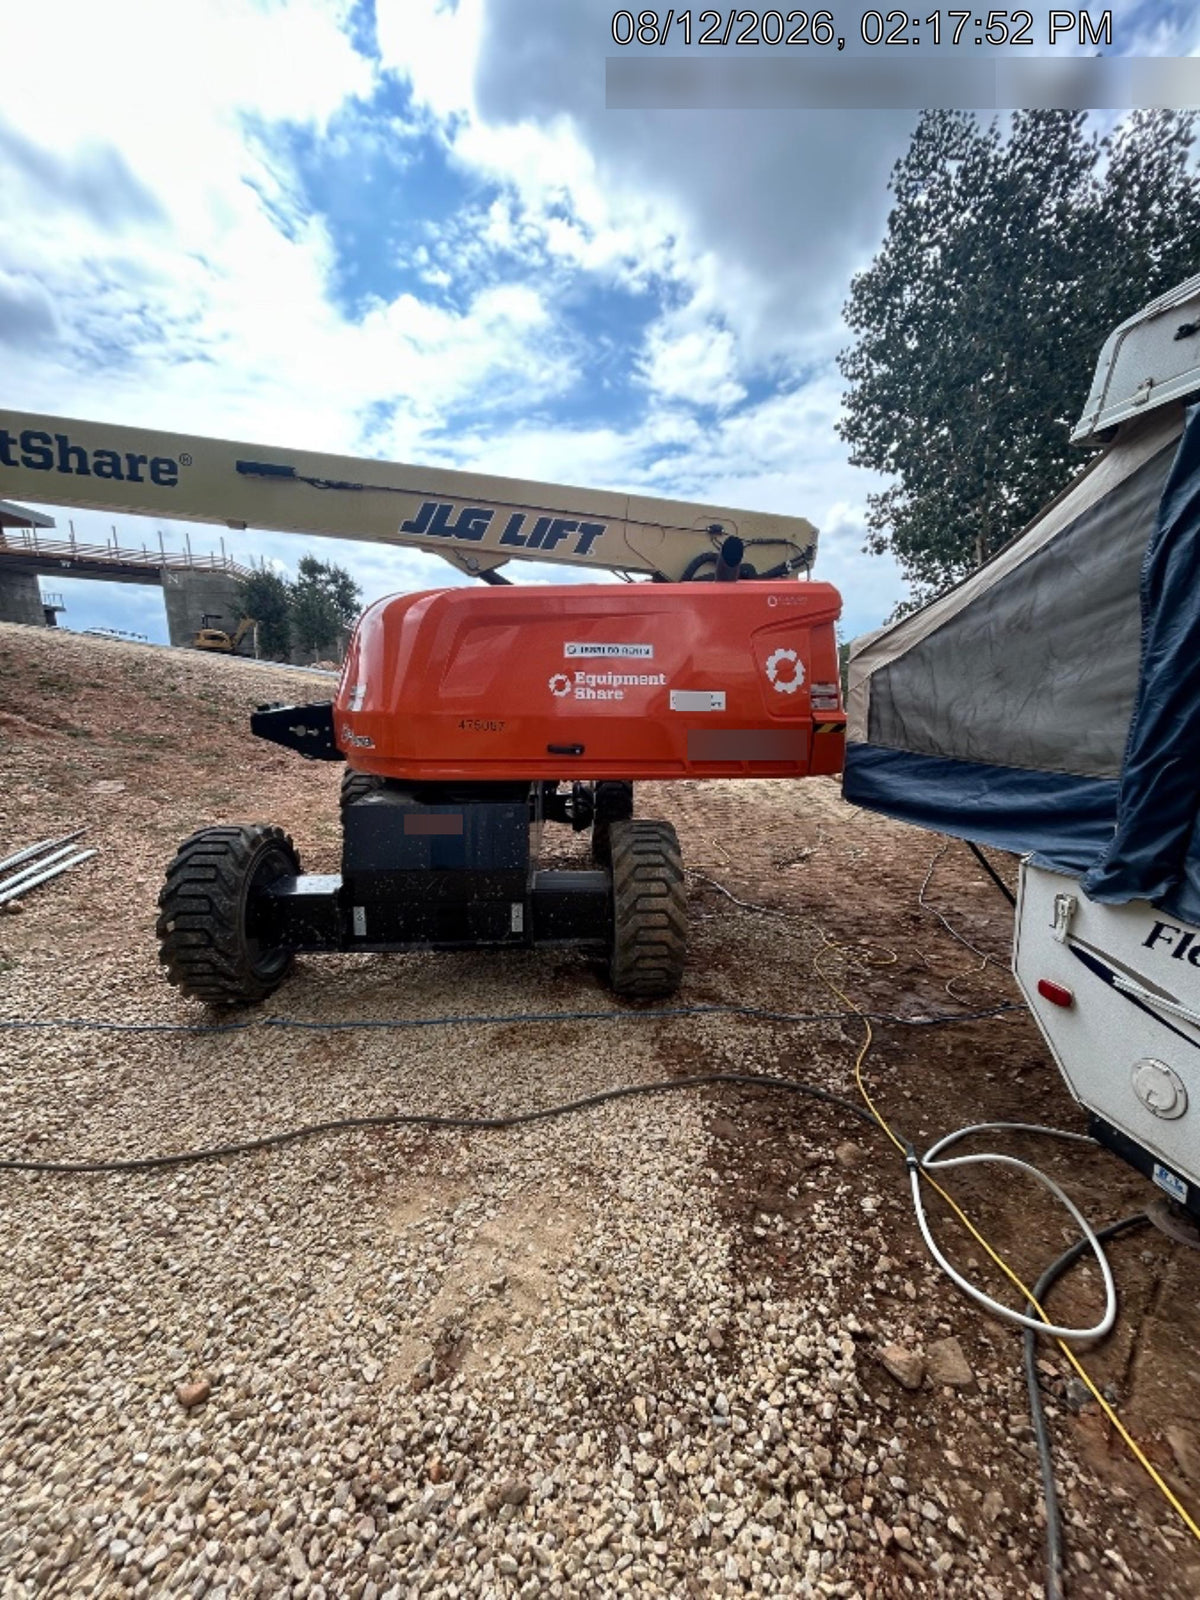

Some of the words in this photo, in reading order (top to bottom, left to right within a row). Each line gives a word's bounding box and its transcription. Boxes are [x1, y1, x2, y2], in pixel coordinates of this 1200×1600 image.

[399, 501, 495, 542] JLG
[499, 511, 608, 556] LIFT
[574, 671, 666, 686] Equipment
[574, 688, 624, 700] Share
